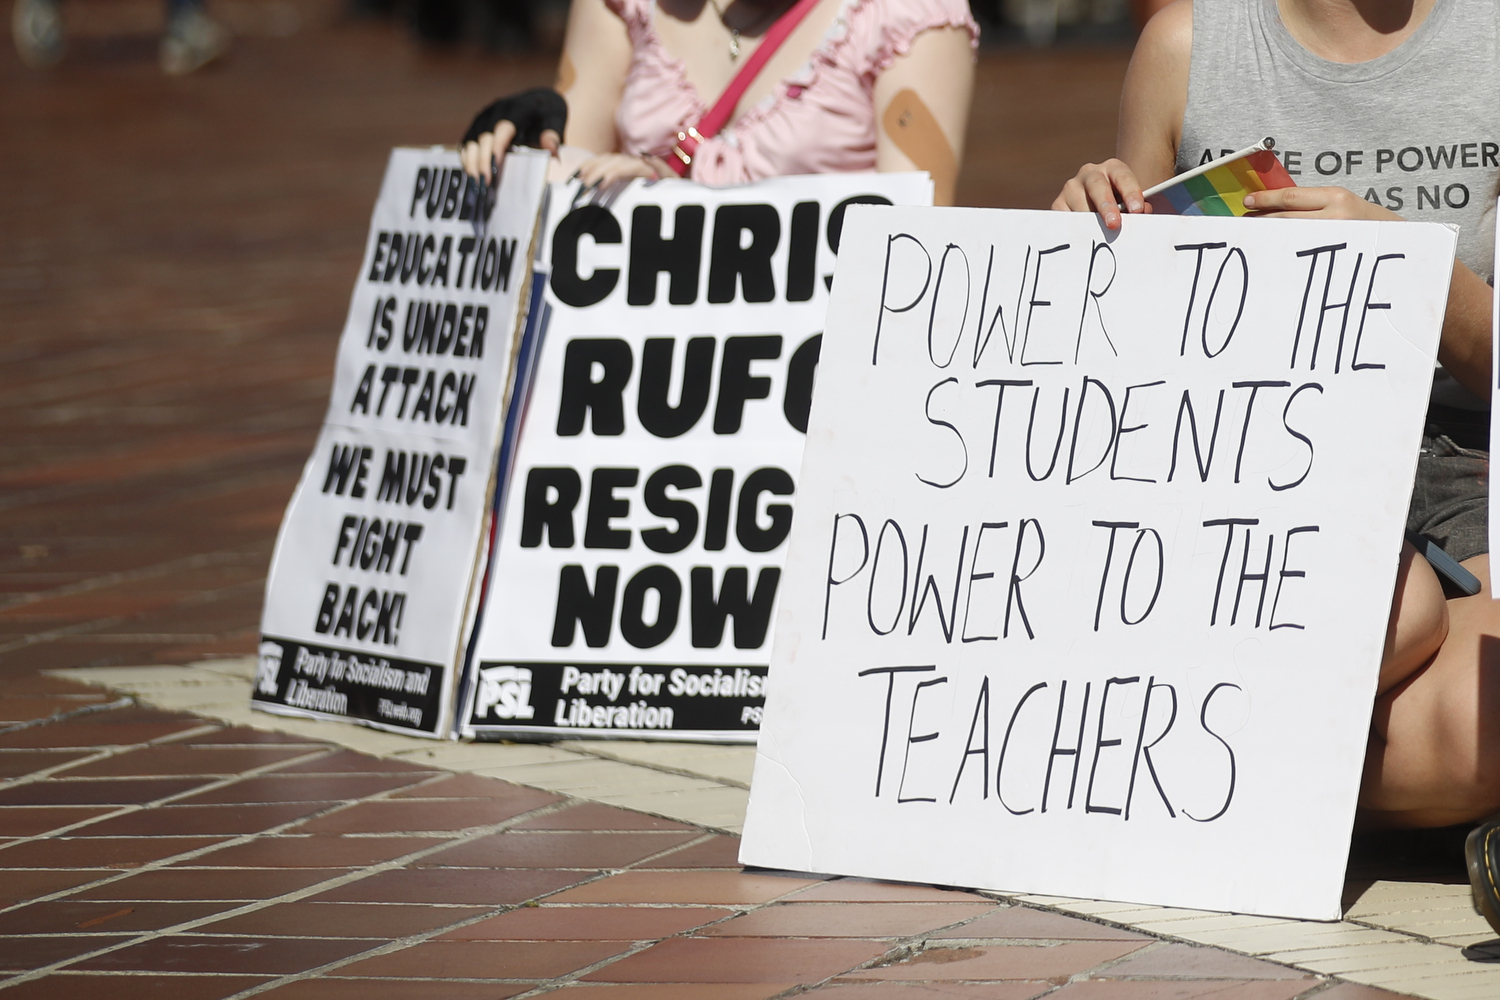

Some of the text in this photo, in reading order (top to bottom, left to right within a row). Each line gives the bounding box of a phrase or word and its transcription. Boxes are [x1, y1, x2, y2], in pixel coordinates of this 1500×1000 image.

[1314, 149, 1363, 175] OF
[1376, 142, 1500, 173] POWER
[1417, 183, 1470, 210] NO
[368, 232, 517, 292] EDUCATION
[367, 297, 489, 359] IS UNDER
[873, 233, 1406, 374] POWER TO THE
[350, 366, 476, 426] ATTACK
[916, 376, 1324, 491] STUDENTS
[322, 444, 466, 511] WE MUST
[520, 464, 796, 555] RESIG
[333, 516, 423, 576] FIGHT
[551, 564, 782, 650] NOW
[822, 514, 1320, 643] POWER TO THE
[315, 583, 407, 646] BACK!
[285, 678, 348, 714] Liberation
[294, 646, 431, 696] Party for Socialism and
[475, 680, 534, 719] PSL
[561, 666, 624, 701] Party
[628, 666, 665, 696] for
[554, 699, 674, 729] Liberation
[858, 665, 1242, 822] TEACHERS
